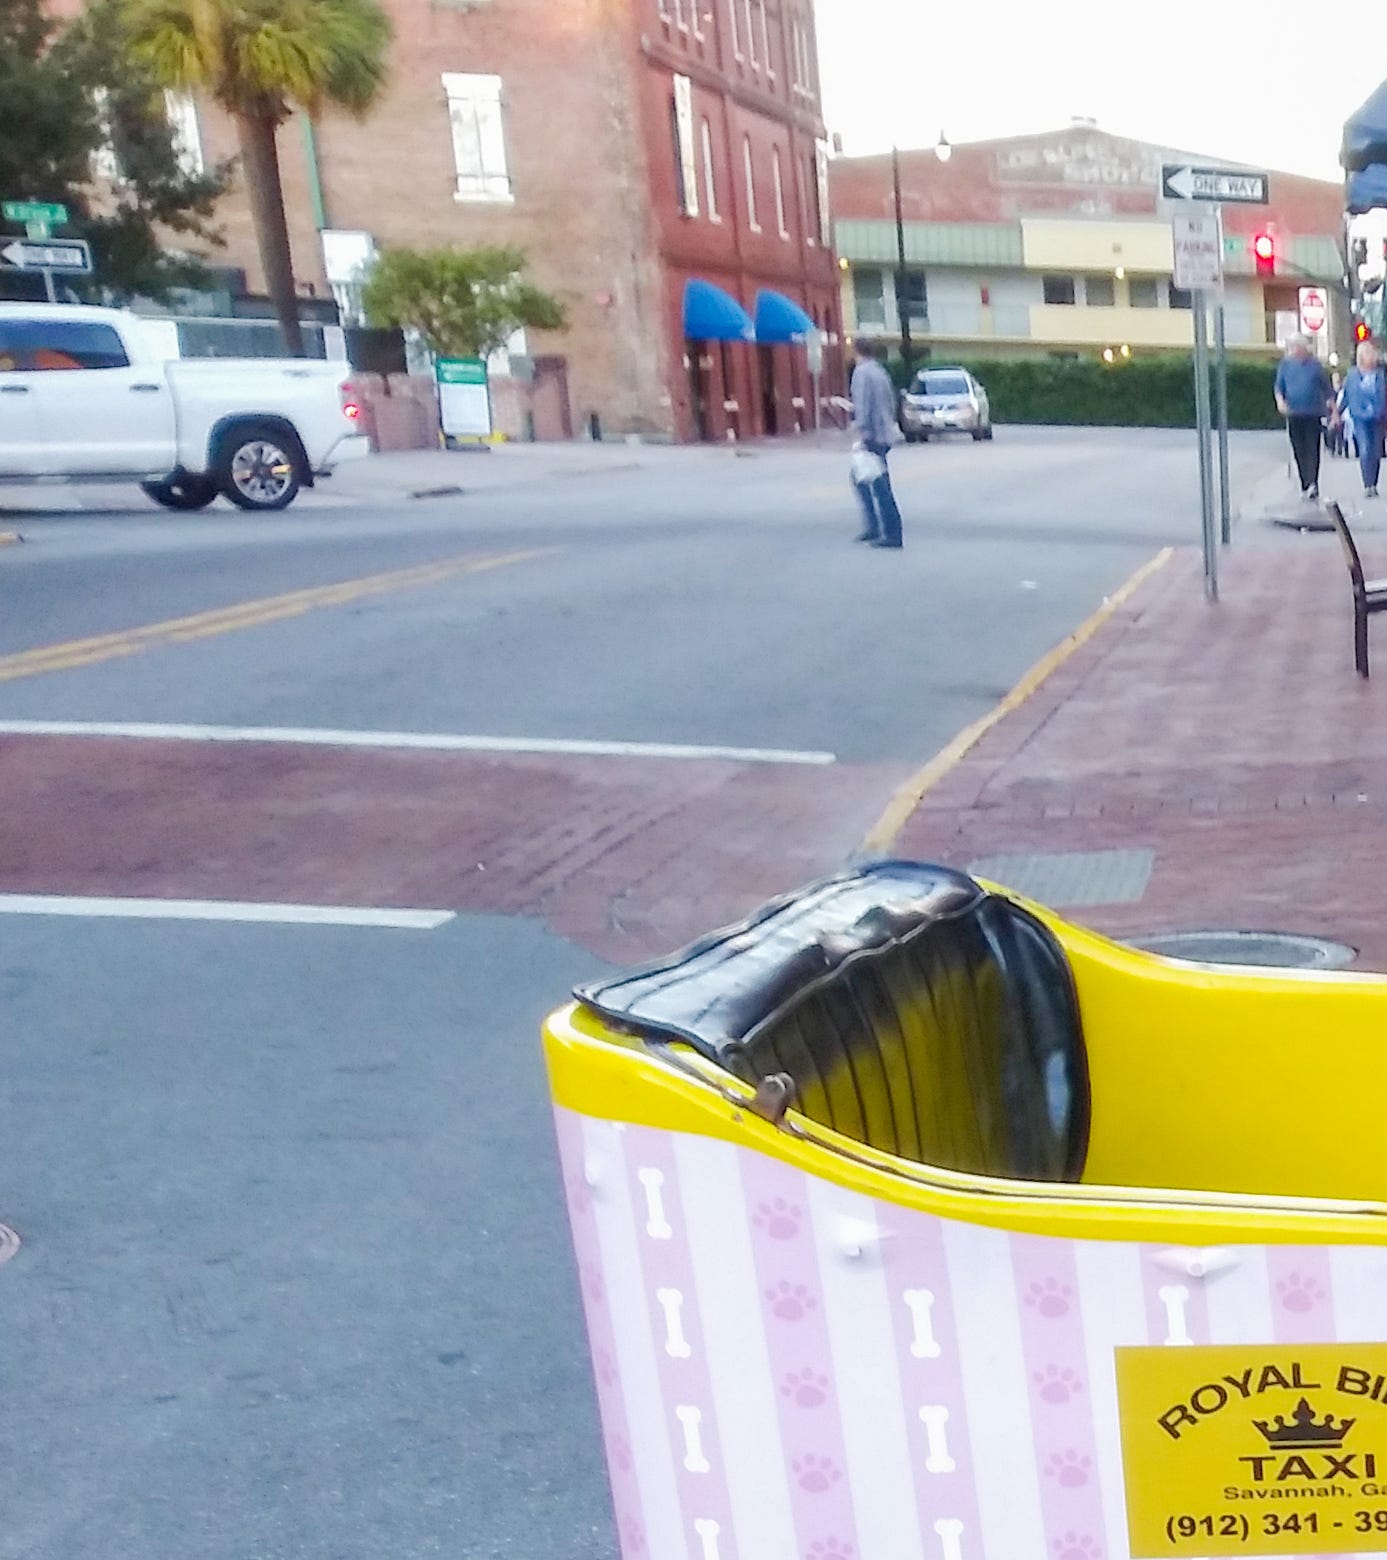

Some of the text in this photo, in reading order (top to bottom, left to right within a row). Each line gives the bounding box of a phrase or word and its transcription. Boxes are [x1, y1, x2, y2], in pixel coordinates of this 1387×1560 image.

[1194, 174, 1259, 196] ONE WAY
[1157, 1363, 1321, 1440] ROYAL
[1238, 1453, 1376, 1481] TAXI
[1223, 1483, 1352, 1500] Savannah,
[1166, 1513, 1250, 1542] (912)
[1262, 1512, 1319, 1535] 341
